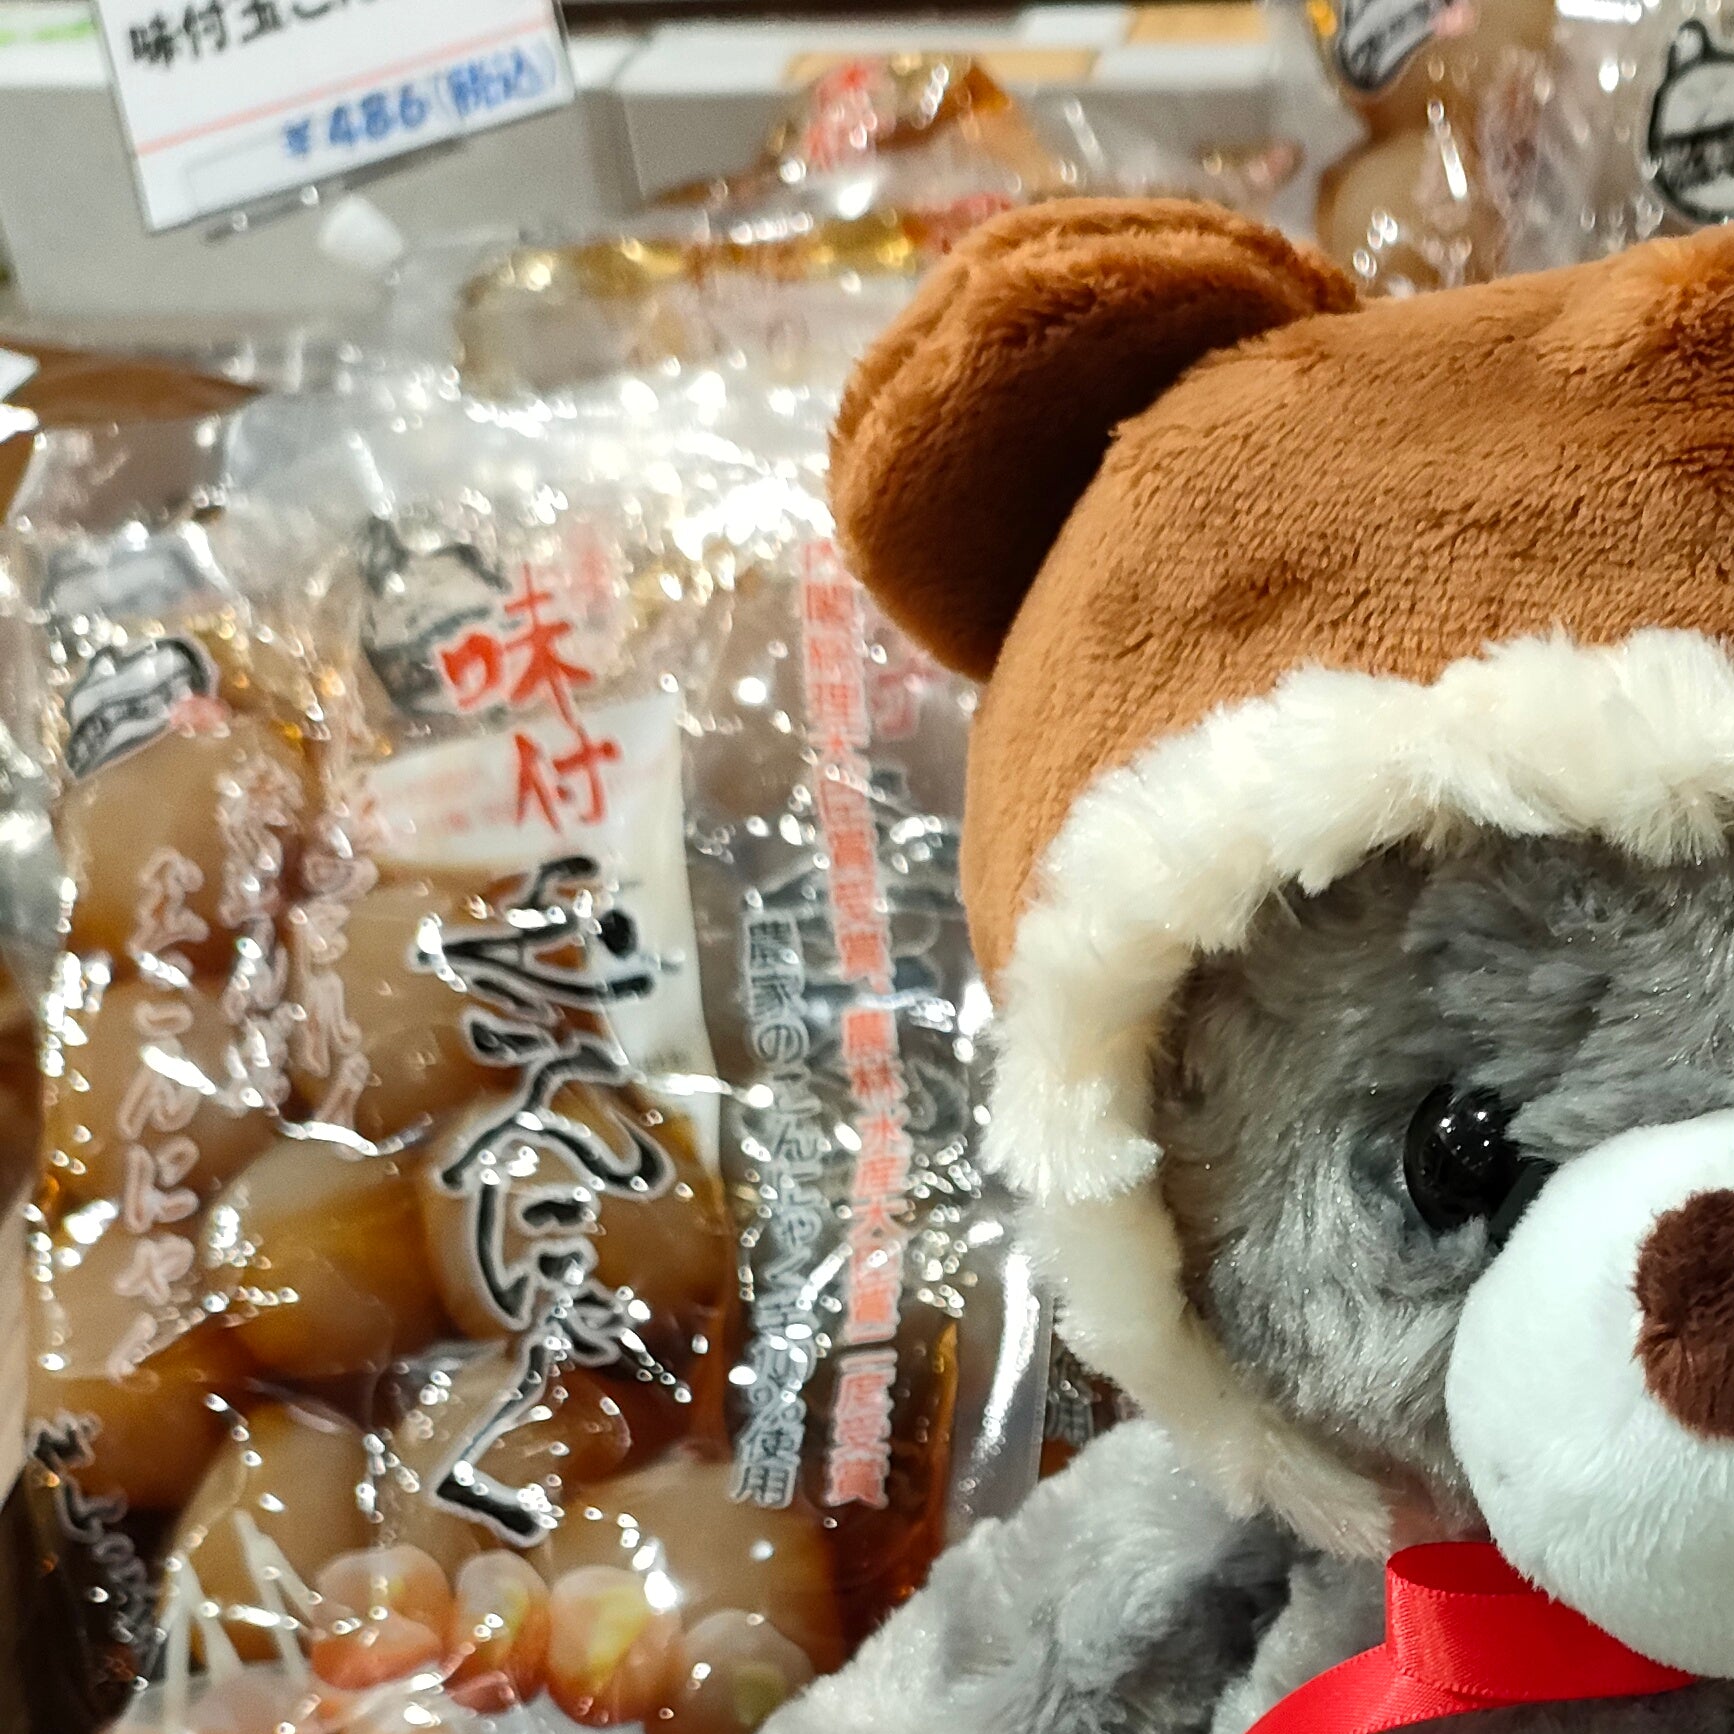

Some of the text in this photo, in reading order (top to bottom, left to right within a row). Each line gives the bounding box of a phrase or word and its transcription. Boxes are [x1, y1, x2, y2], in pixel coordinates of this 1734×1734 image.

[128, 0, 372, 66] 味付玉
[440, 562, 622, 834] 味付
